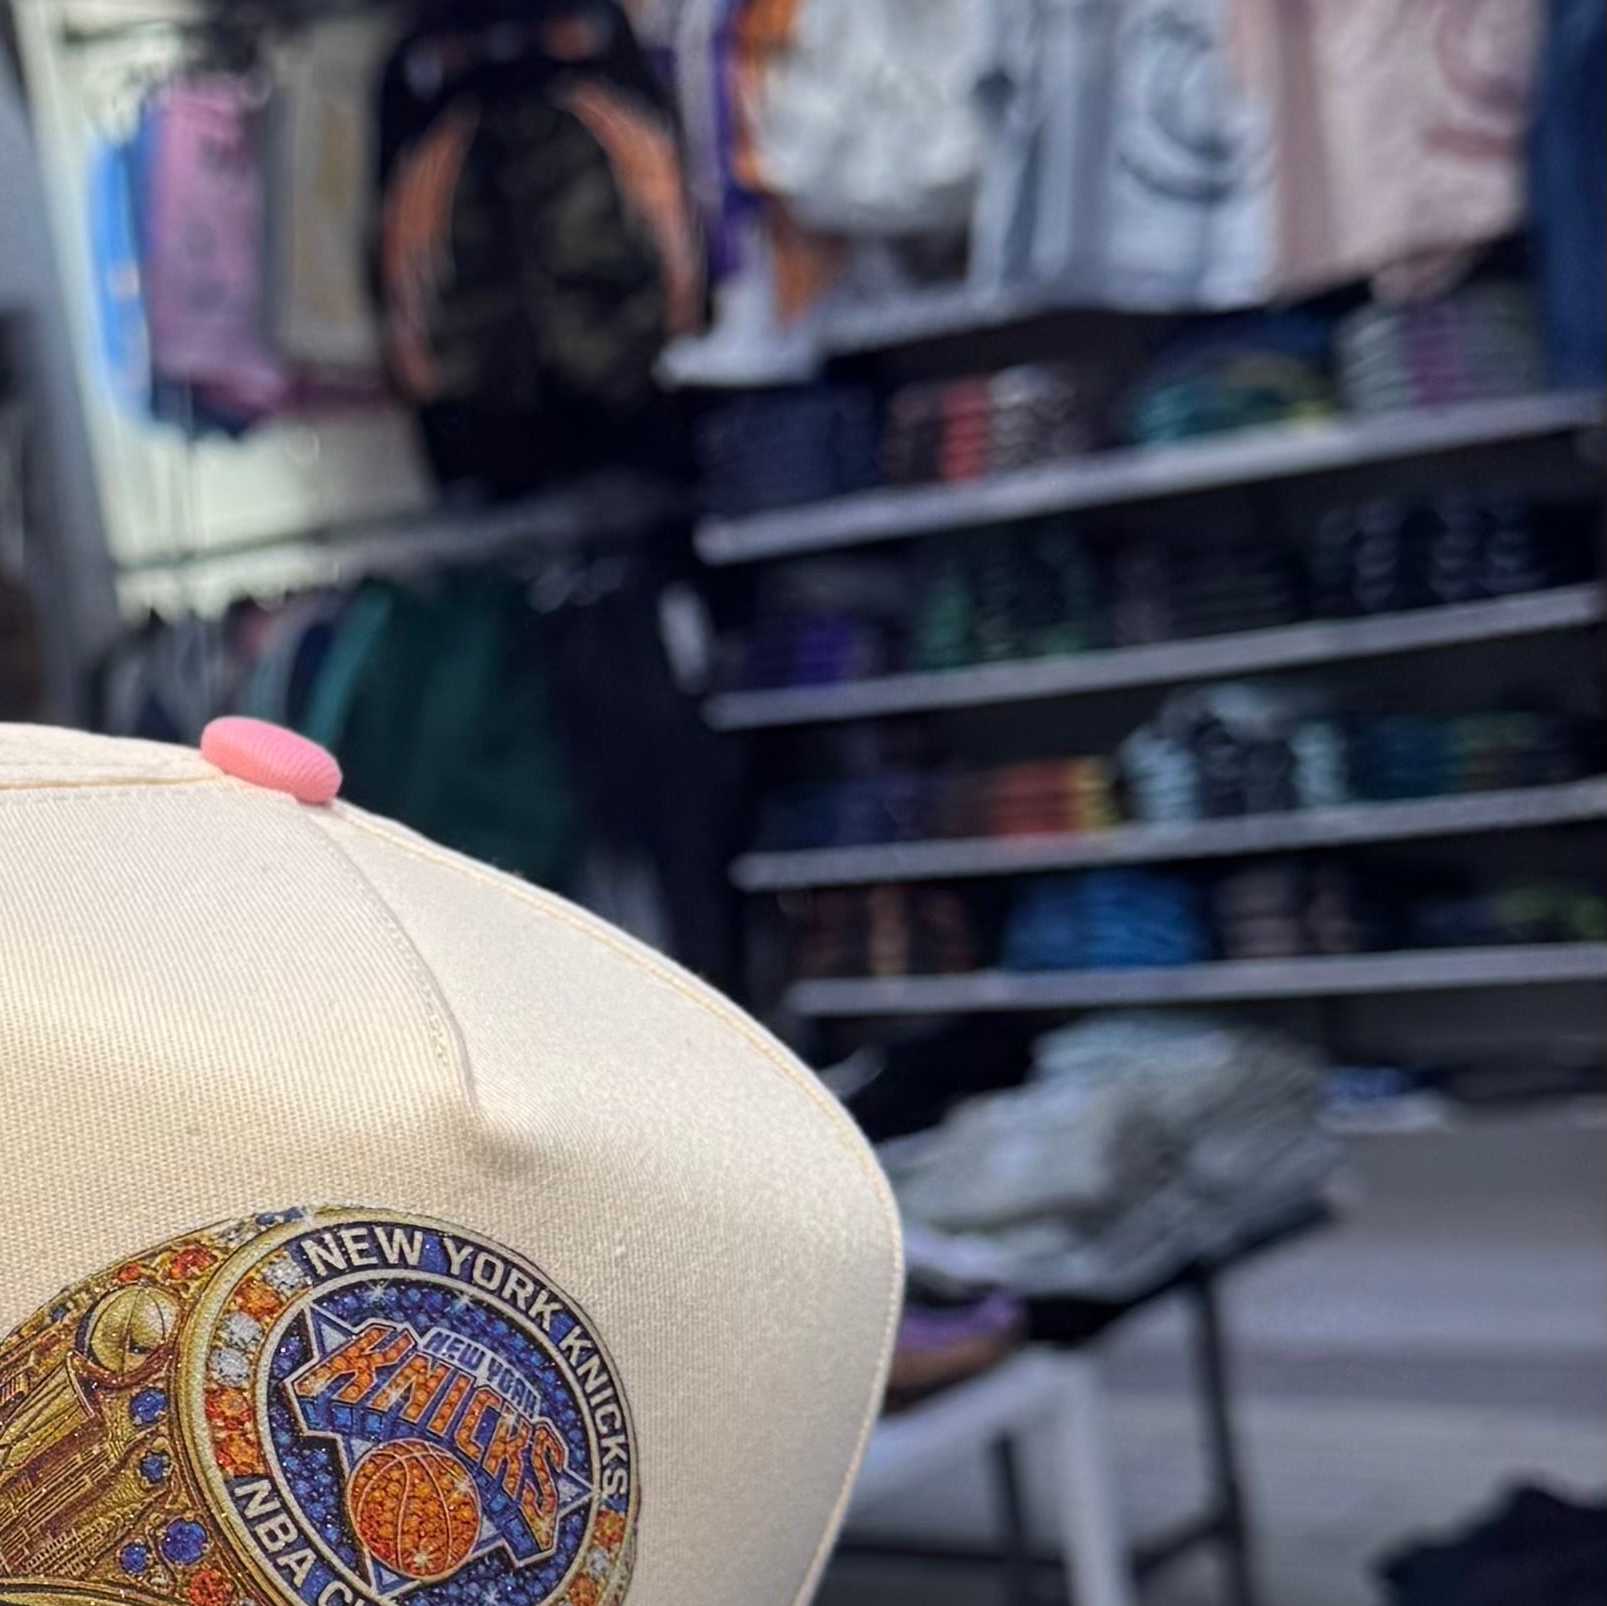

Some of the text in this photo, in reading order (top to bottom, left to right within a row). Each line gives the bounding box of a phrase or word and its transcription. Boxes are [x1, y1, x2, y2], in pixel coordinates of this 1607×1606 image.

[300, 1225, 630, 1498] NEW YORK KNICKS
[422, 1330, 486, 1372] NEW
[293, 1324, 566, 1552] KNICKS
[233, 1477, 319, 1588] NBA
